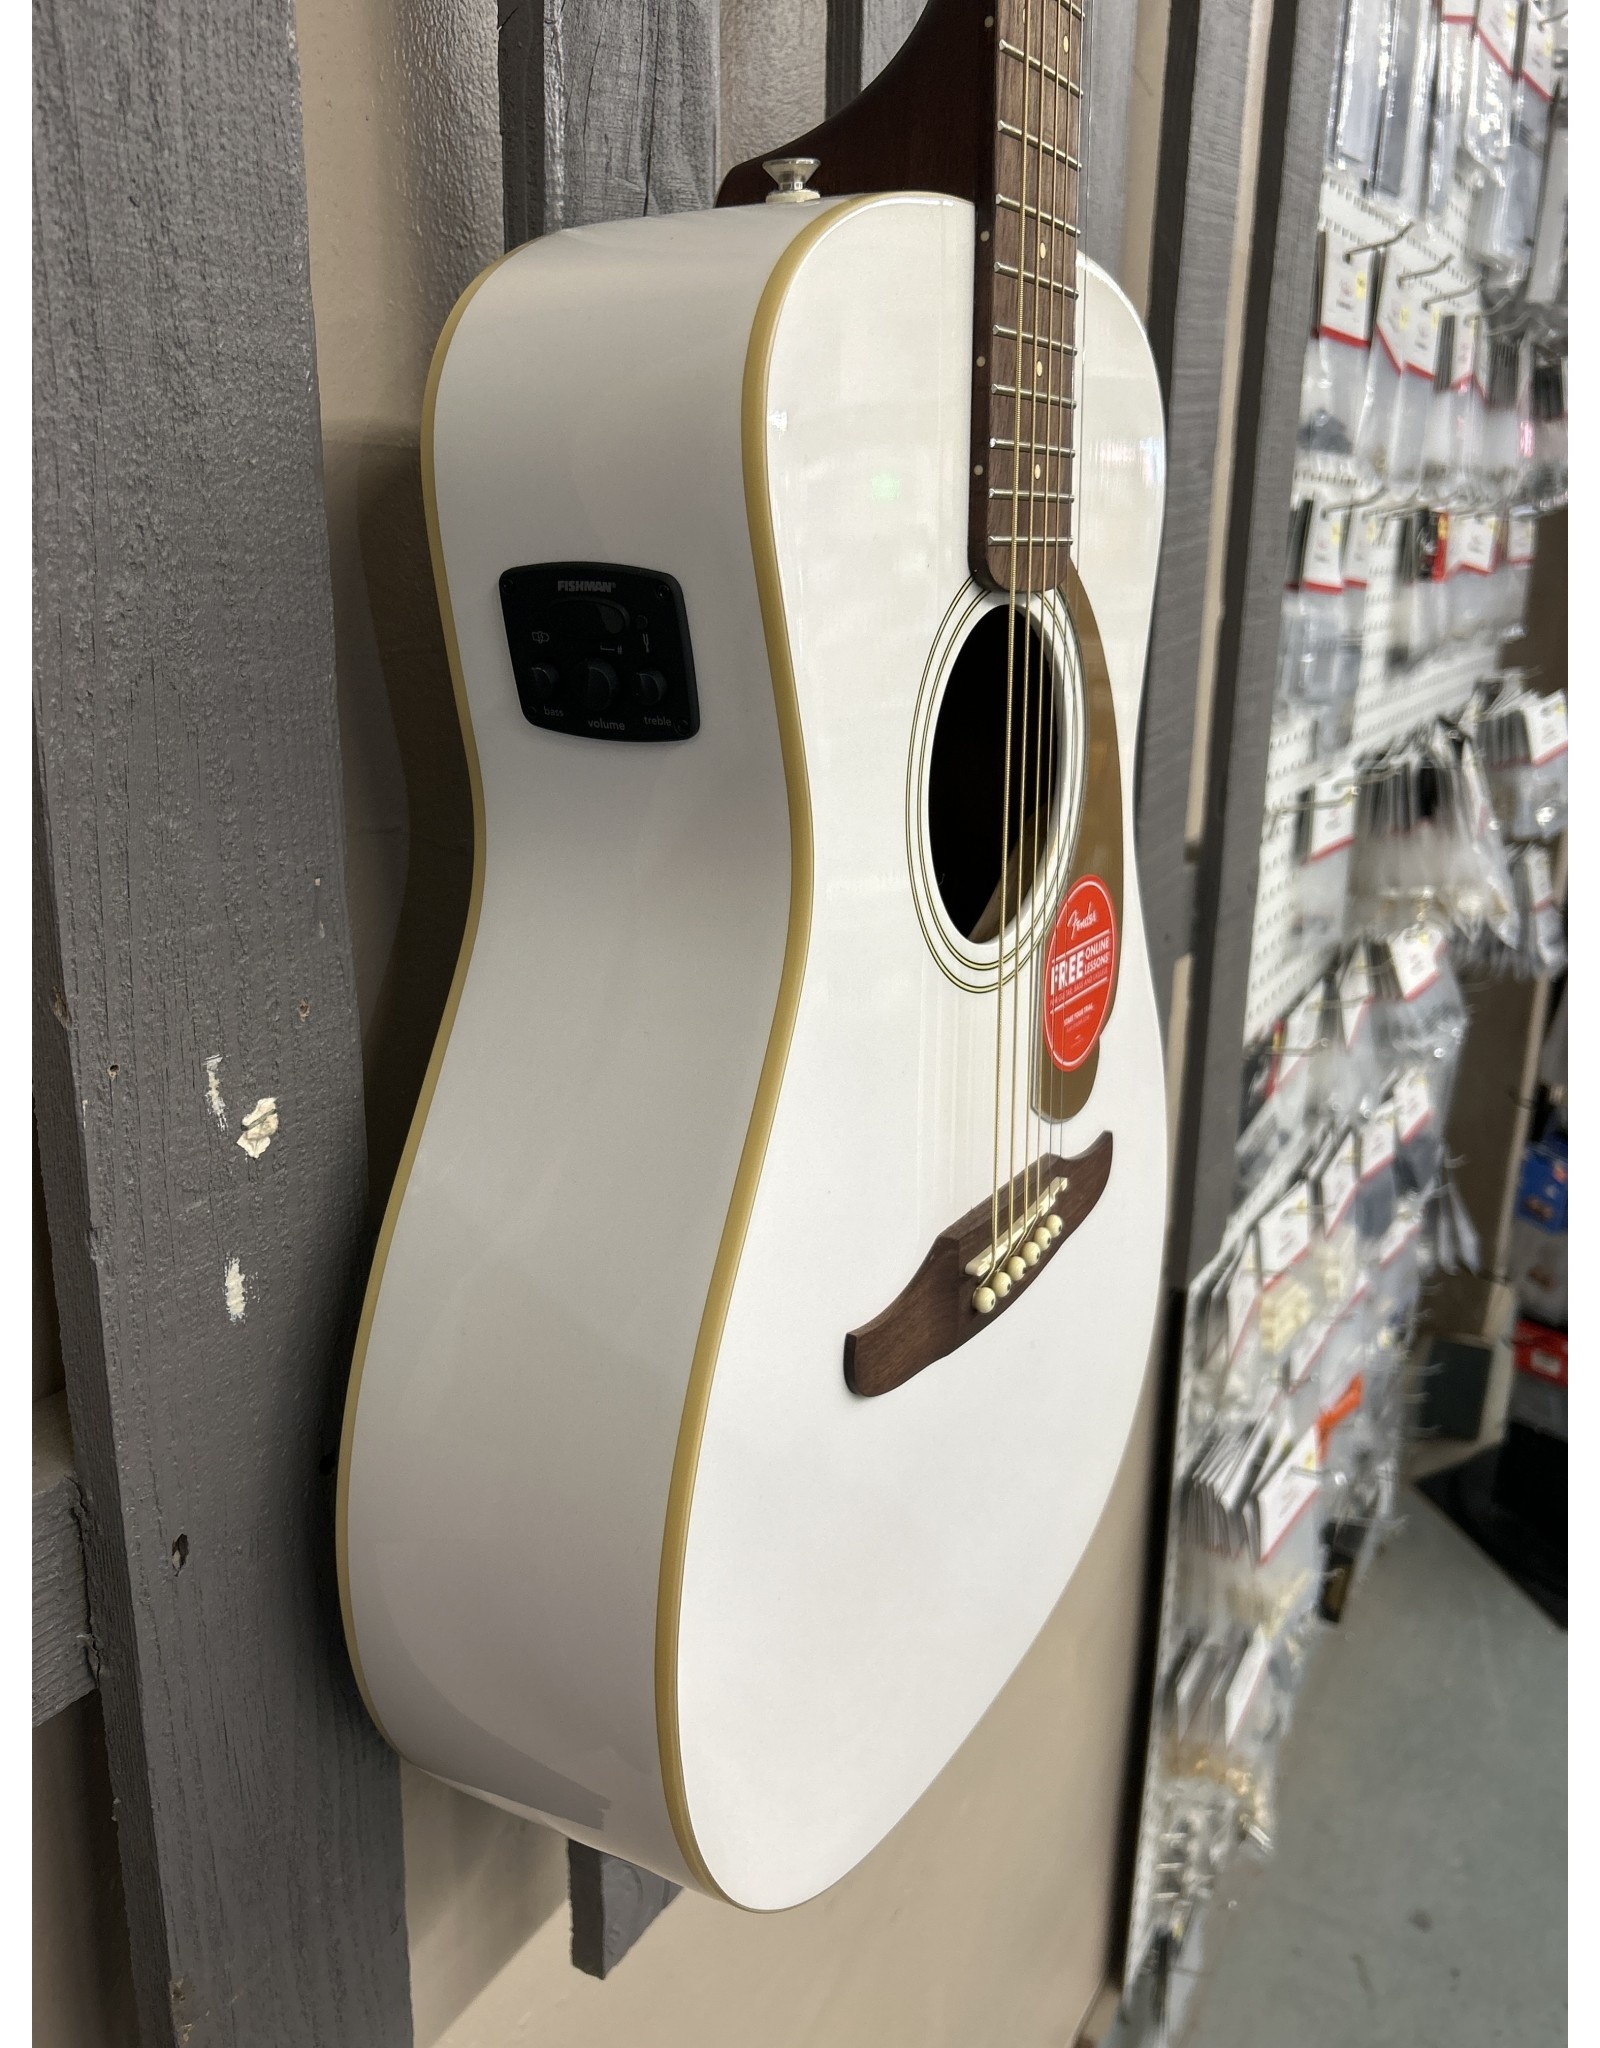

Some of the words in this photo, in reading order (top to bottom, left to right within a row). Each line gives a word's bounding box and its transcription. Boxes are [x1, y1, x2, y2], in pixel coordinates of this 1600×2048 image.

[557, 580, 612, 593] FISHMAN
[543, 705, 565, 717] bass
[587, 718, 626, 731] volume
[643, 715, 672, 726] treble
[1051, 949, 1084, 996] FREE
[1085, 936, 1110, 960] ONLINE
[1084, 954, 1109, 975] LESSONS
